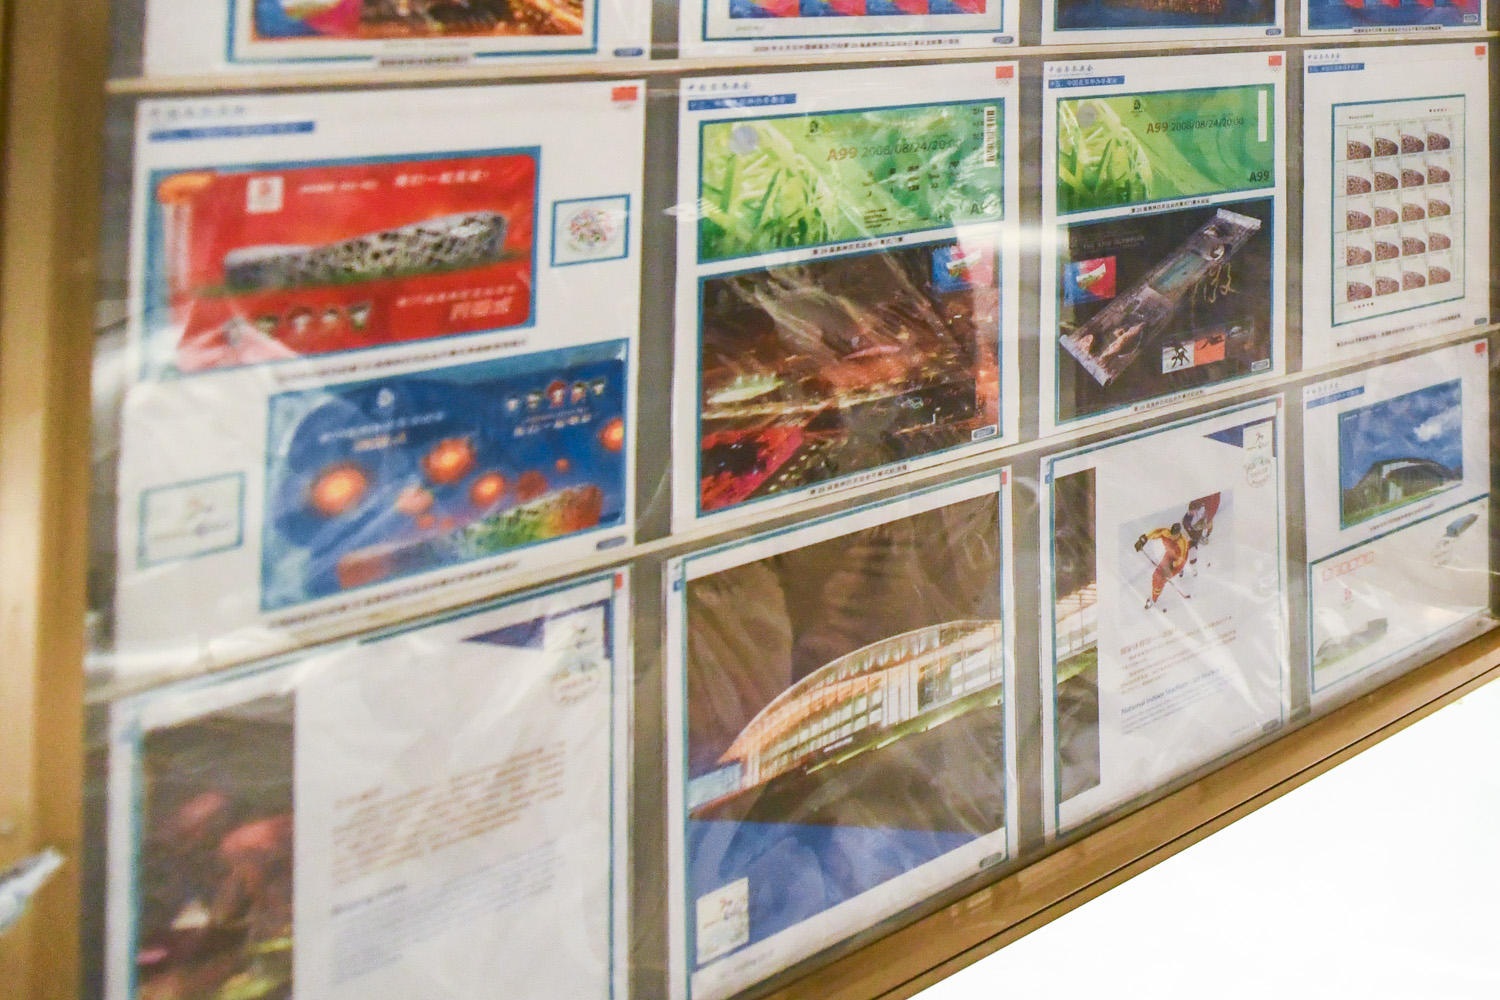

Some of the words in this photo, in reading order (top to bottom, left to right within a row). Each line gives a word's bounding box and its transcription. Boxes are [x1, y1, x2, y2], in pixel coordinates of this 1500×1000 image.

[1146, 121, 1169, 135] A99
[827, 146, 859, 162] A99
[1249, 170, 1270, 183] A99
[1121, 699, 1146, 715] National
